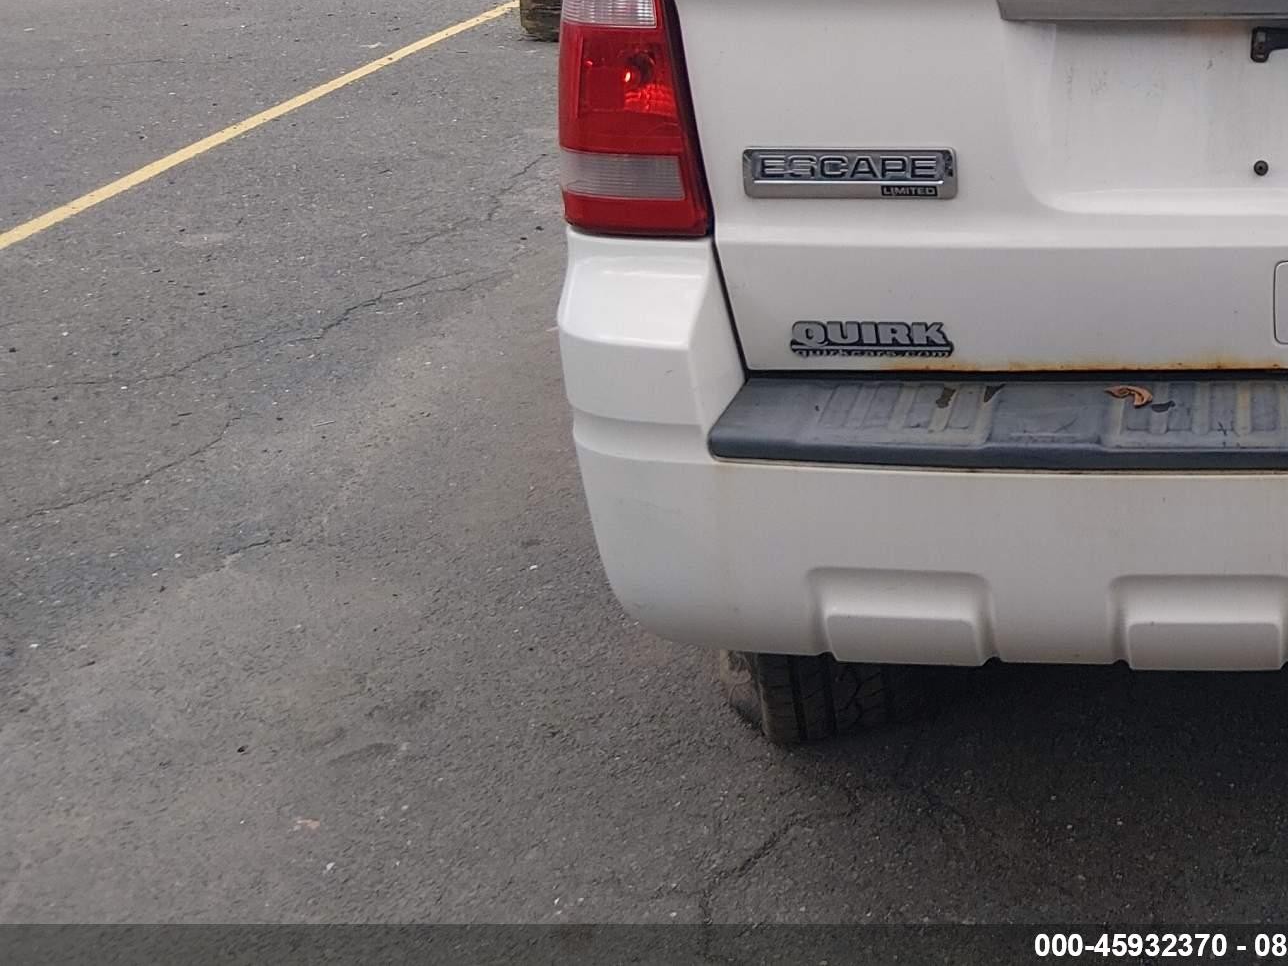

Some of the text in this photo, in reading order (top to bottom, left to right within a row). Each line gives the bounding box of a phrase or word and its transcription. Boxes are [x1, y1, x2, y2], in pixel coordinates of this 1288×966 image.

[759, 155, 938, 179] ESCAPE
[883, 186, 937, 196] LIMITED
[792, 321, 948, 346] QUIRK
